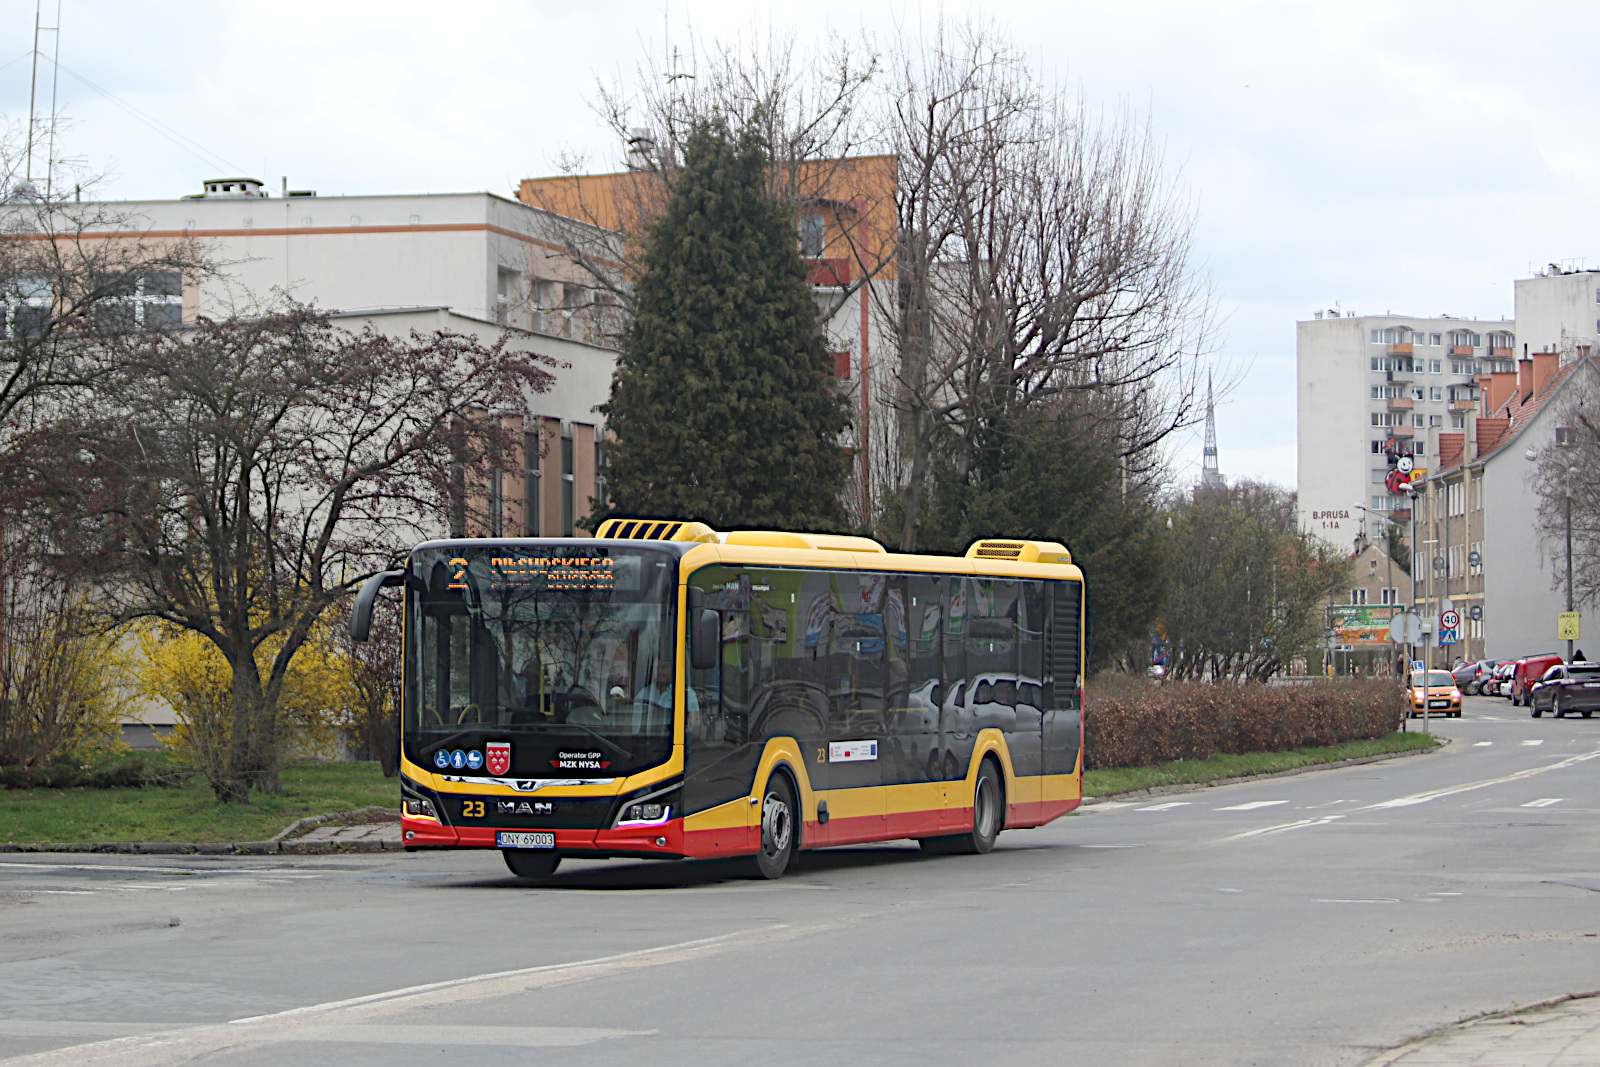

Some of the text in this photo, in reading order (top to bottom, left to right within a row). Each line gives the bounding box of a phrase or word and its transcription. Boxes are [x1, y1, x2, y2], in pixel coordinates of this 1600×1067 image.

[1312, 510, 1349, 519] B.PRUSA
[1322, 520, 1339, 529] 1-1A
[1444, 615, 1457, 624] 40
[559, 751, 587, 759] Operator
[817, 748, 826, 763] 23
[559, 760, 601, 769] MZK NYSA
[462, 801, 485, 817] 23
[497, 801, 552, 814] MAN
[501, 833, 553, 845] ONY 69003
